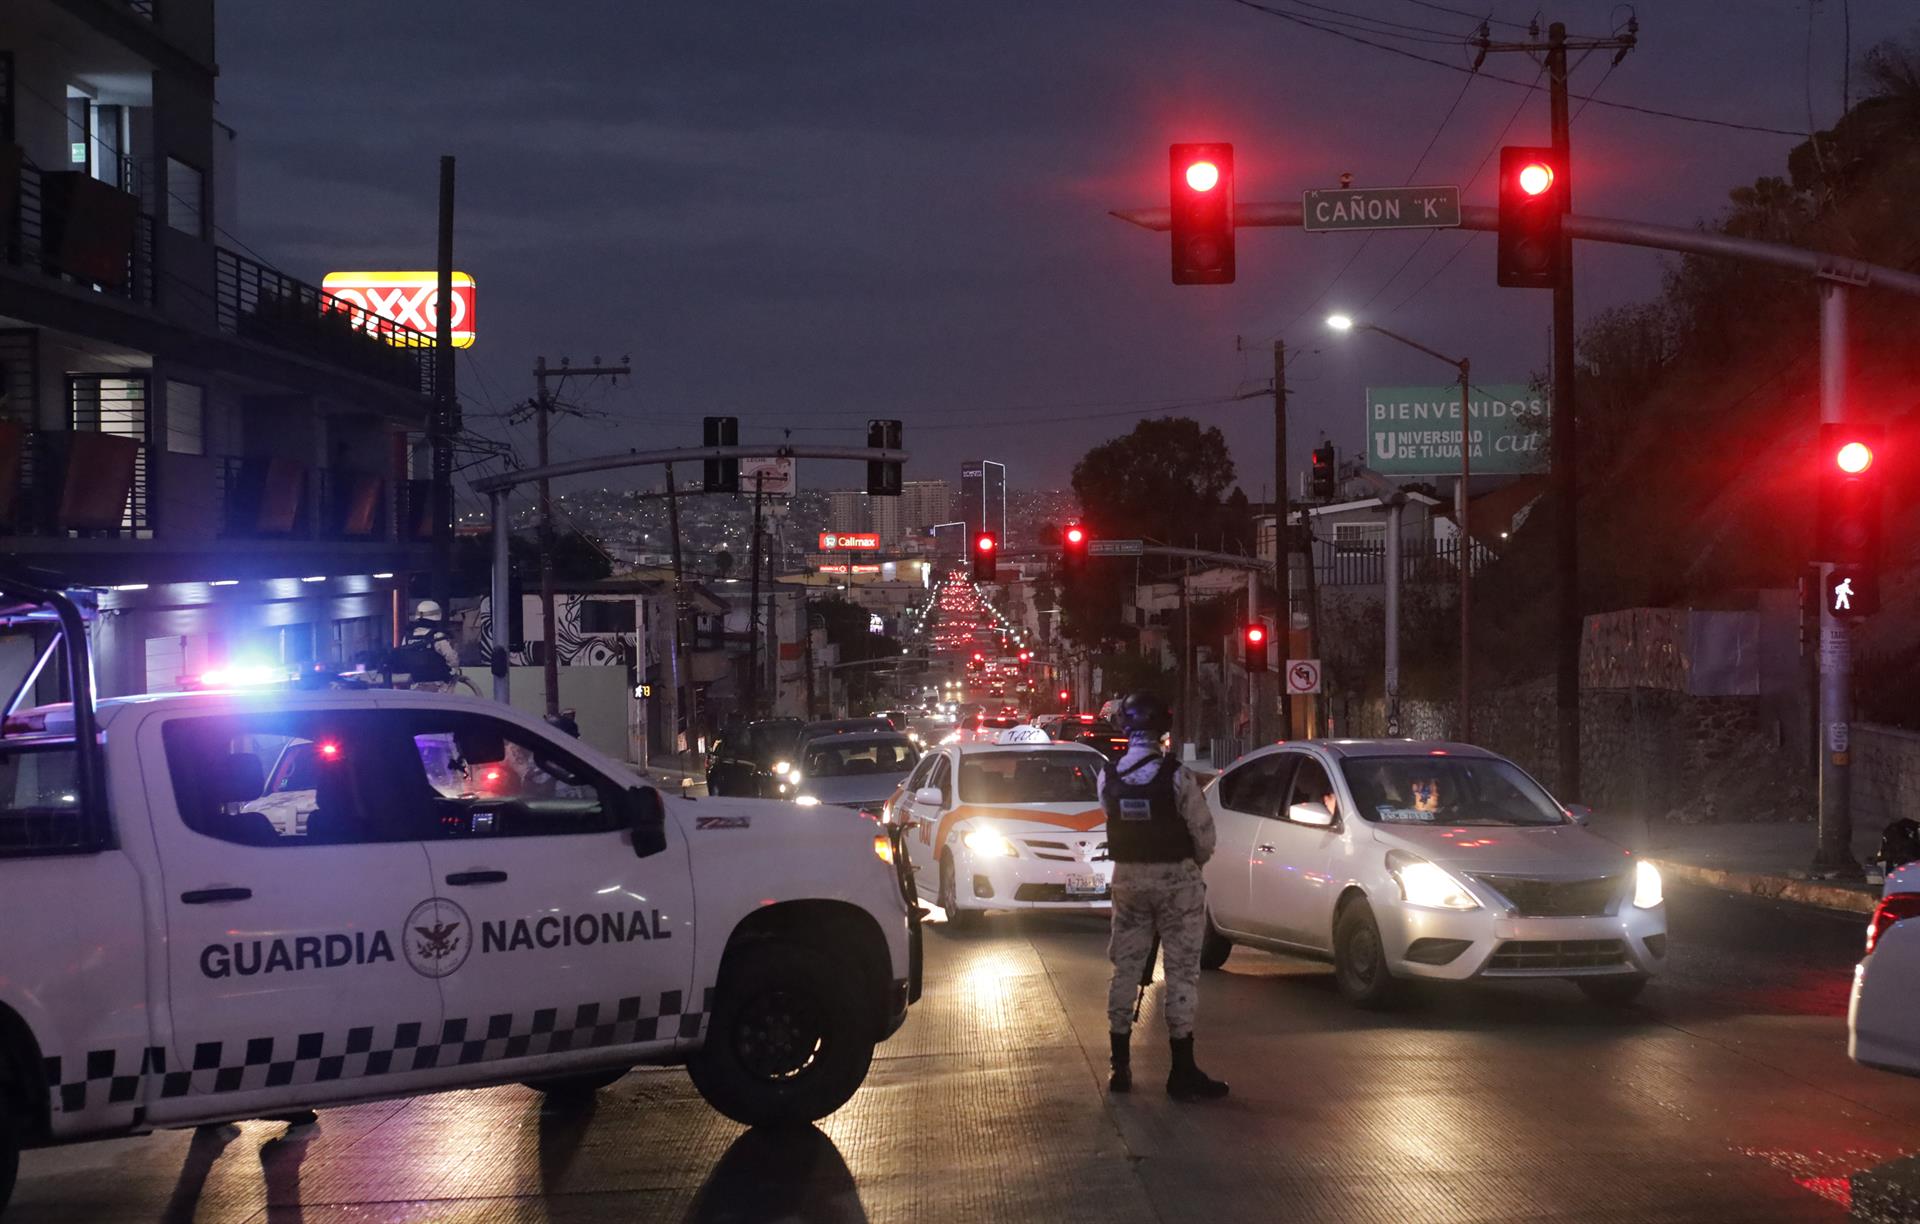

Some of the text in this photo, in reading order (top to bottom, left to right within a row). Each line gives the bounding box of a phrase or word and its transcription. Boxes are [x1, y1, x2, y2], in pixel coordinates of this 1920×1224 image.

[1316, 195, 1400, 222] CAÑON
[328, 288, 466, 330] OXXO
[1374, 400, 1542, 420] BIENVENIDOS
[1399, 445, 1483, 459] DE TIJUAA
[1495, 431, 1543, 452] cut
[838, 536, 875, 547] Calimax
[200, 909, 672, 979] GUARDIA NACIONAL
